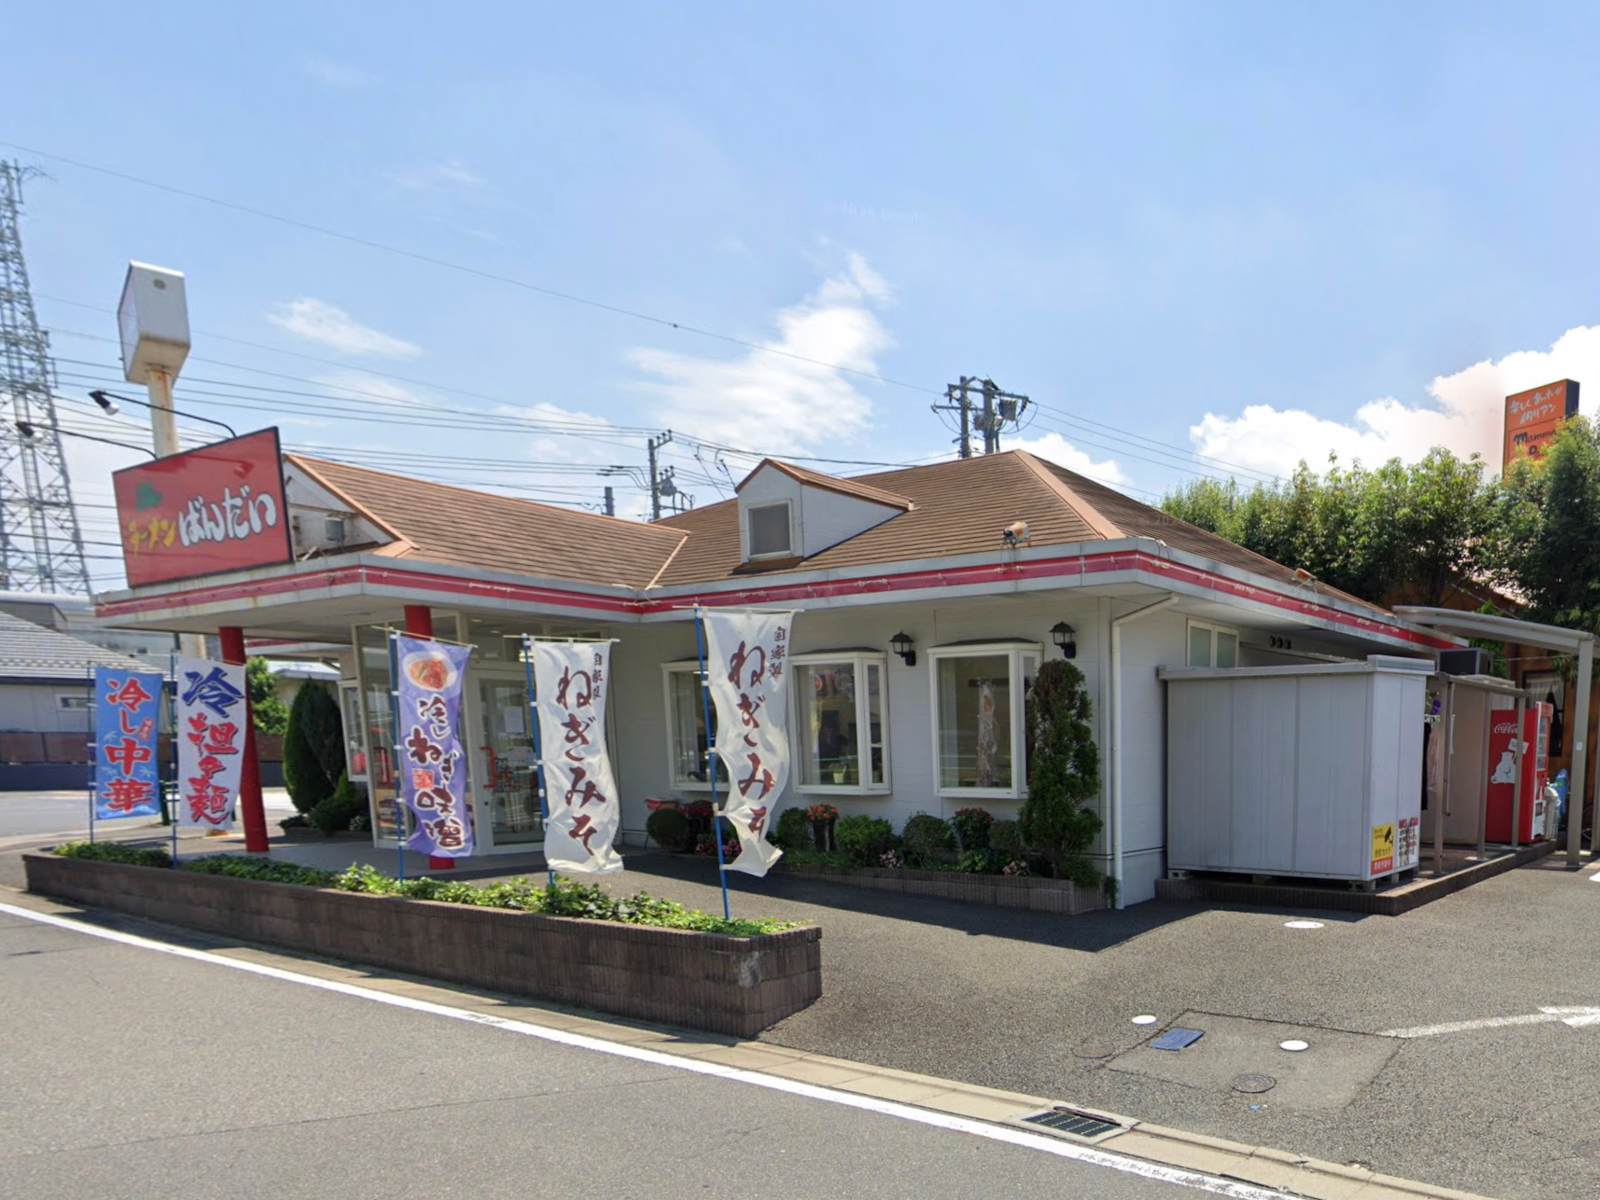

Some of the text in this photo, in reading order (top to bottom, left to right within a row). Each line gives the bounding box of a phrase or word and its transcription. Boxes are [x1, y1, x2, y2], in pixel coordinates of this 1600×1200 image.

[1519, 403, 1557, 425] イタリアン
[127, 485, 277, 556] ラーメン ばんだい
[769, 626, 787, 680] 自家製
[102, 677, 155, 814] 冷し中華
[556, 665, 607, 857] ねぎみそ
[728, 640, 777, 843] ねぎみそ
[1494, 722, 1519, 734] Coca-Co
